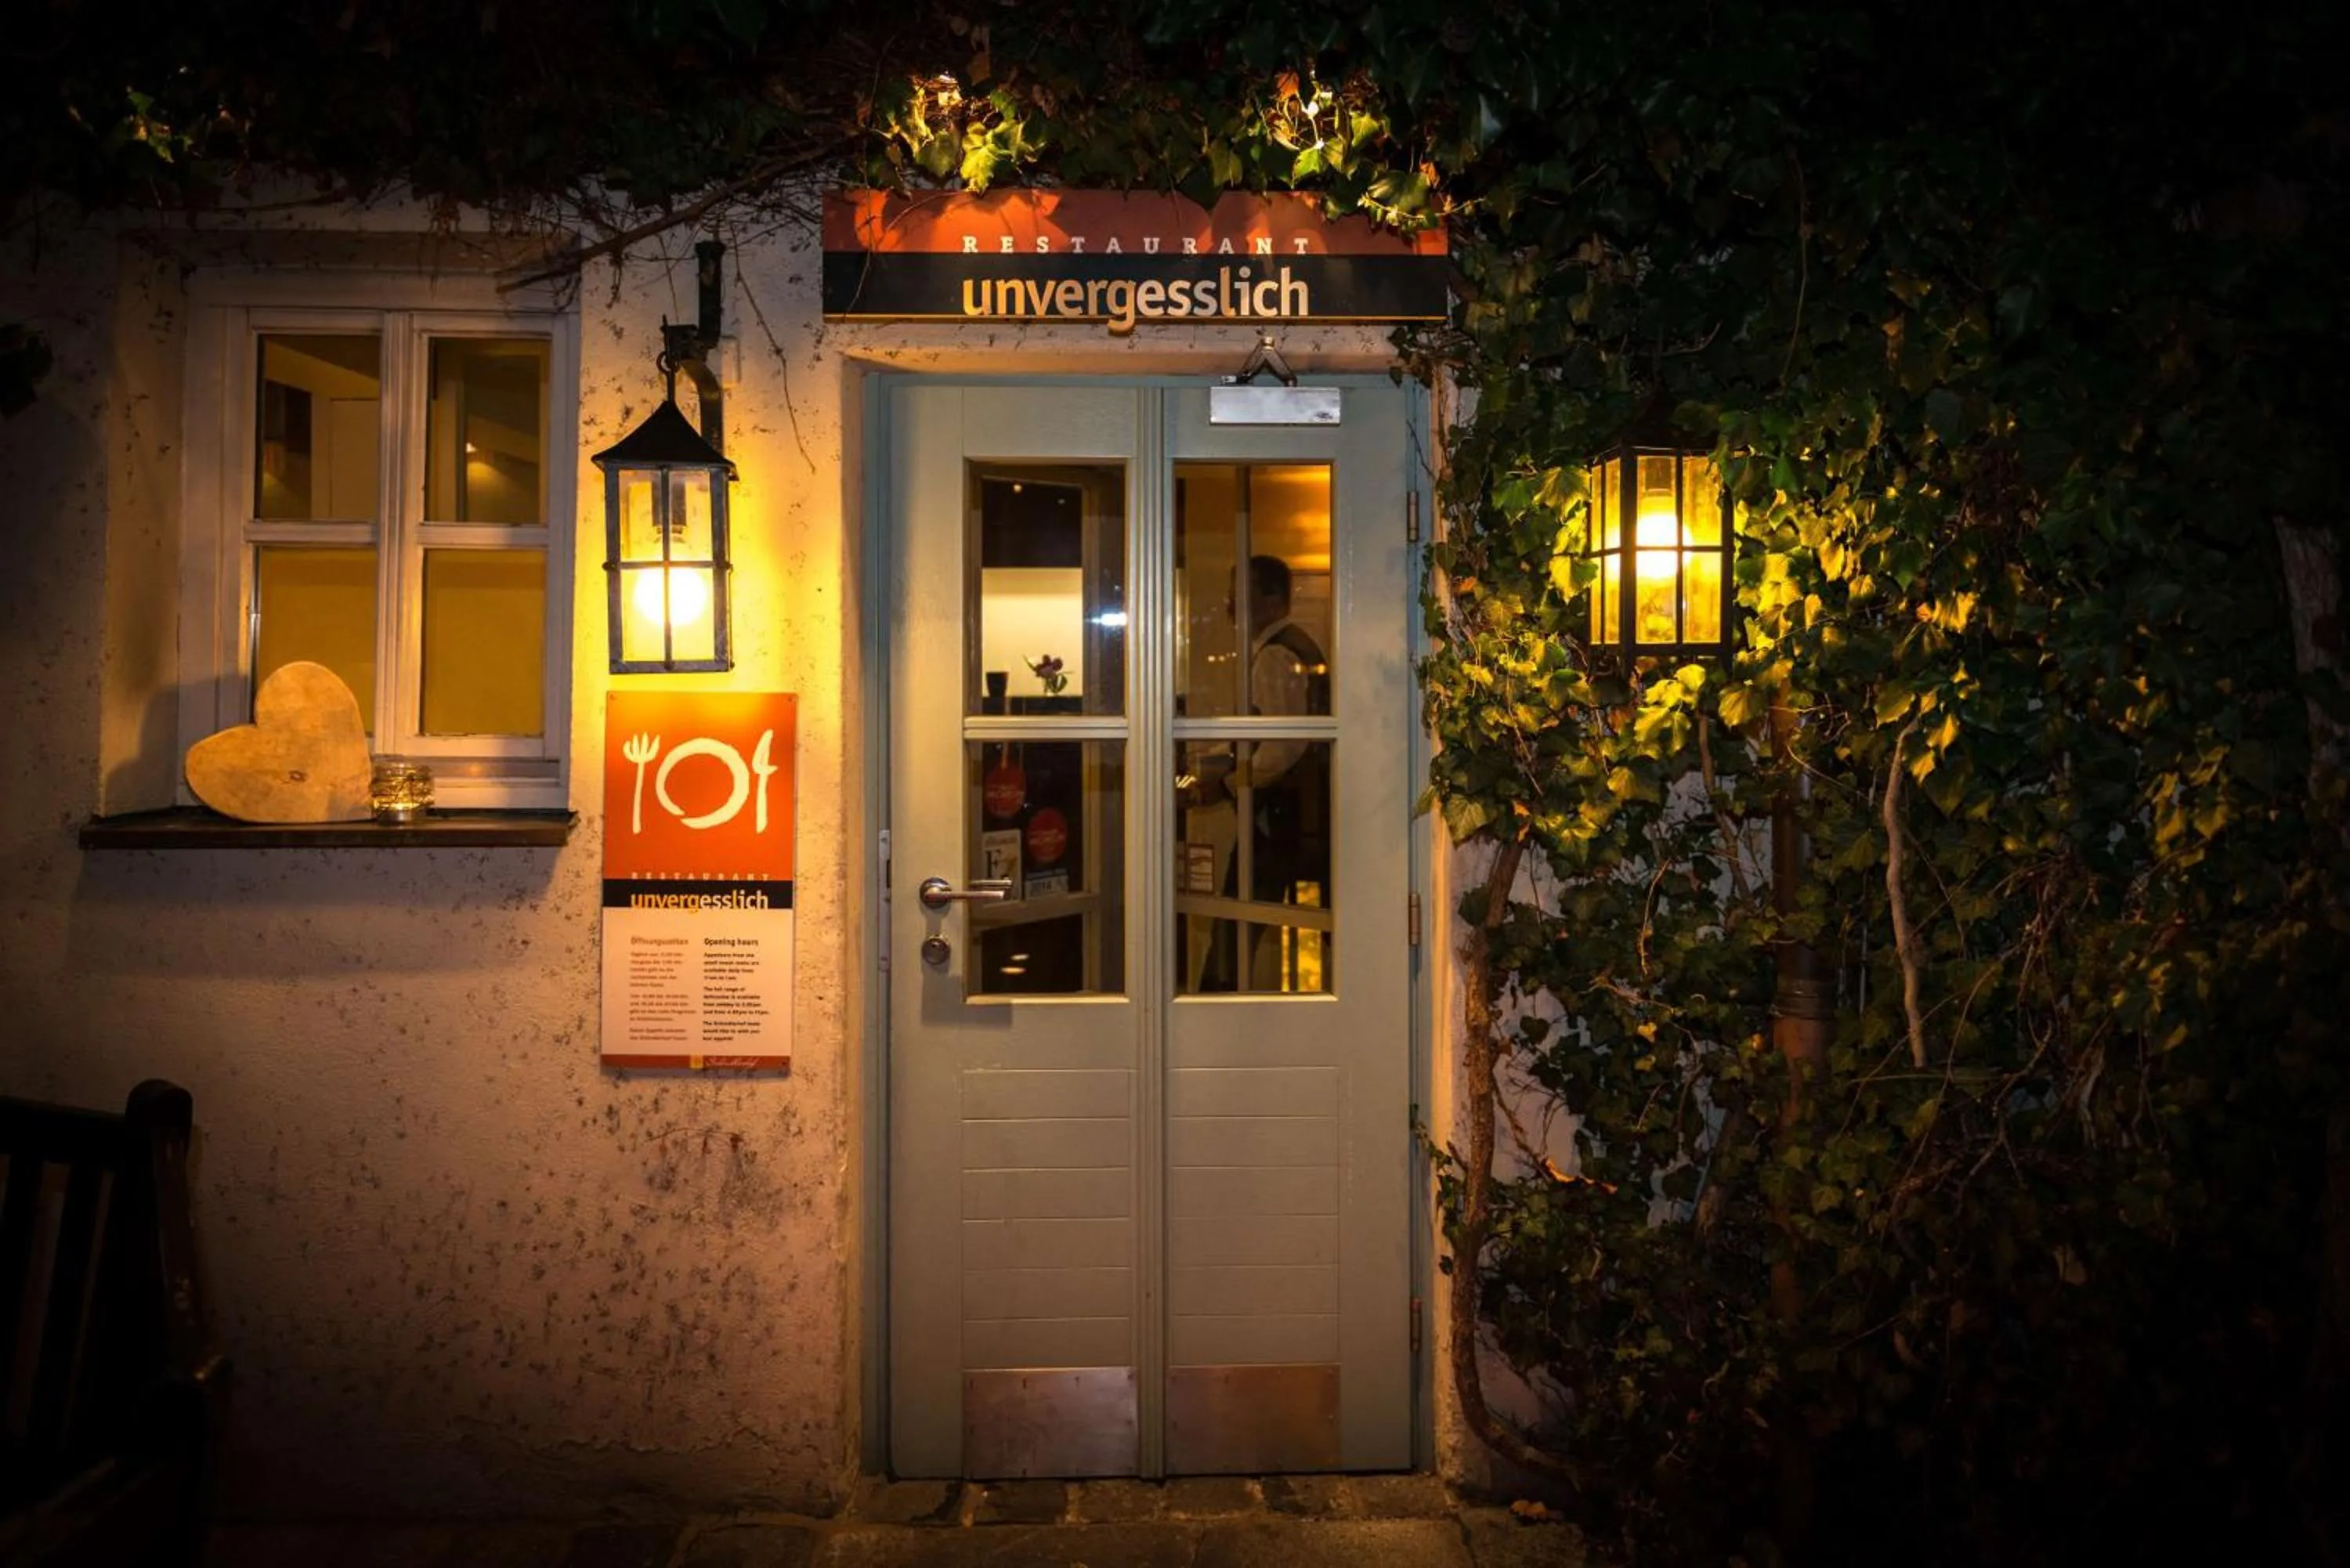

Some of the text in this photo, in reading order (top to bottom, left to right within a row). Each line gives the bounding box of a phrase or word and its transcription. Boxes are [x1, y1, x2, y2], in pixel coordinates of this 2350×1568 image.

[963, 236, 1310, 255] RESTAURANT
[963, 266, 1310, 334] unvergesslich
[631, 872, 769, 881] RESTAURANT
[631, 889, 769, 914] unvergesslich
[703, 938, 736, 947] Opening
